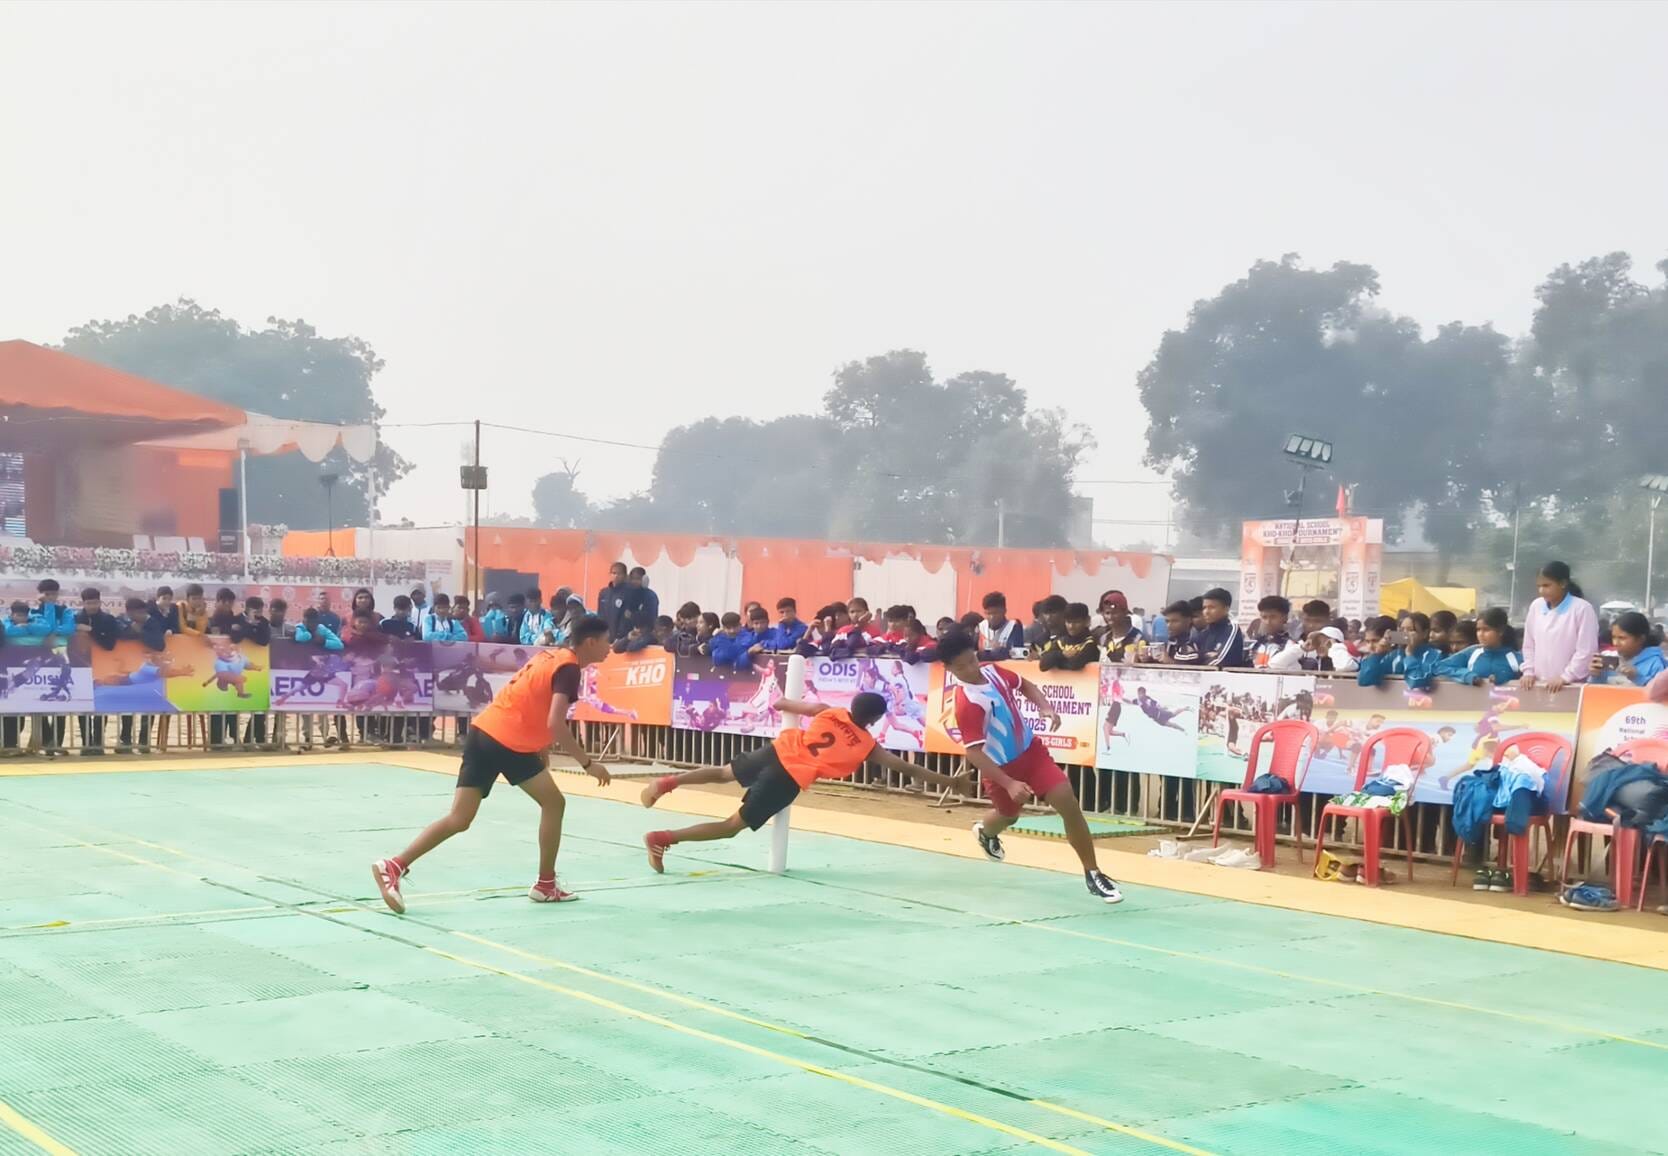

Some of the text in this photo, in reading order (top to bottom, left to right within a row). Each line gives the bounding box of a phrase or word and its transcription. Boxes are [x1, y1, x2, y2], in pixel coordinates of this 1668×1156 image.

[1293, 528, 1343, 537] OURNAMENT
[625, 664, 666, 686] KHO
[1042, 684, 1075, 699] SCHOOL
[1625, 715, 1646, 725] 69th
[808, 732, 836, 757] 2
